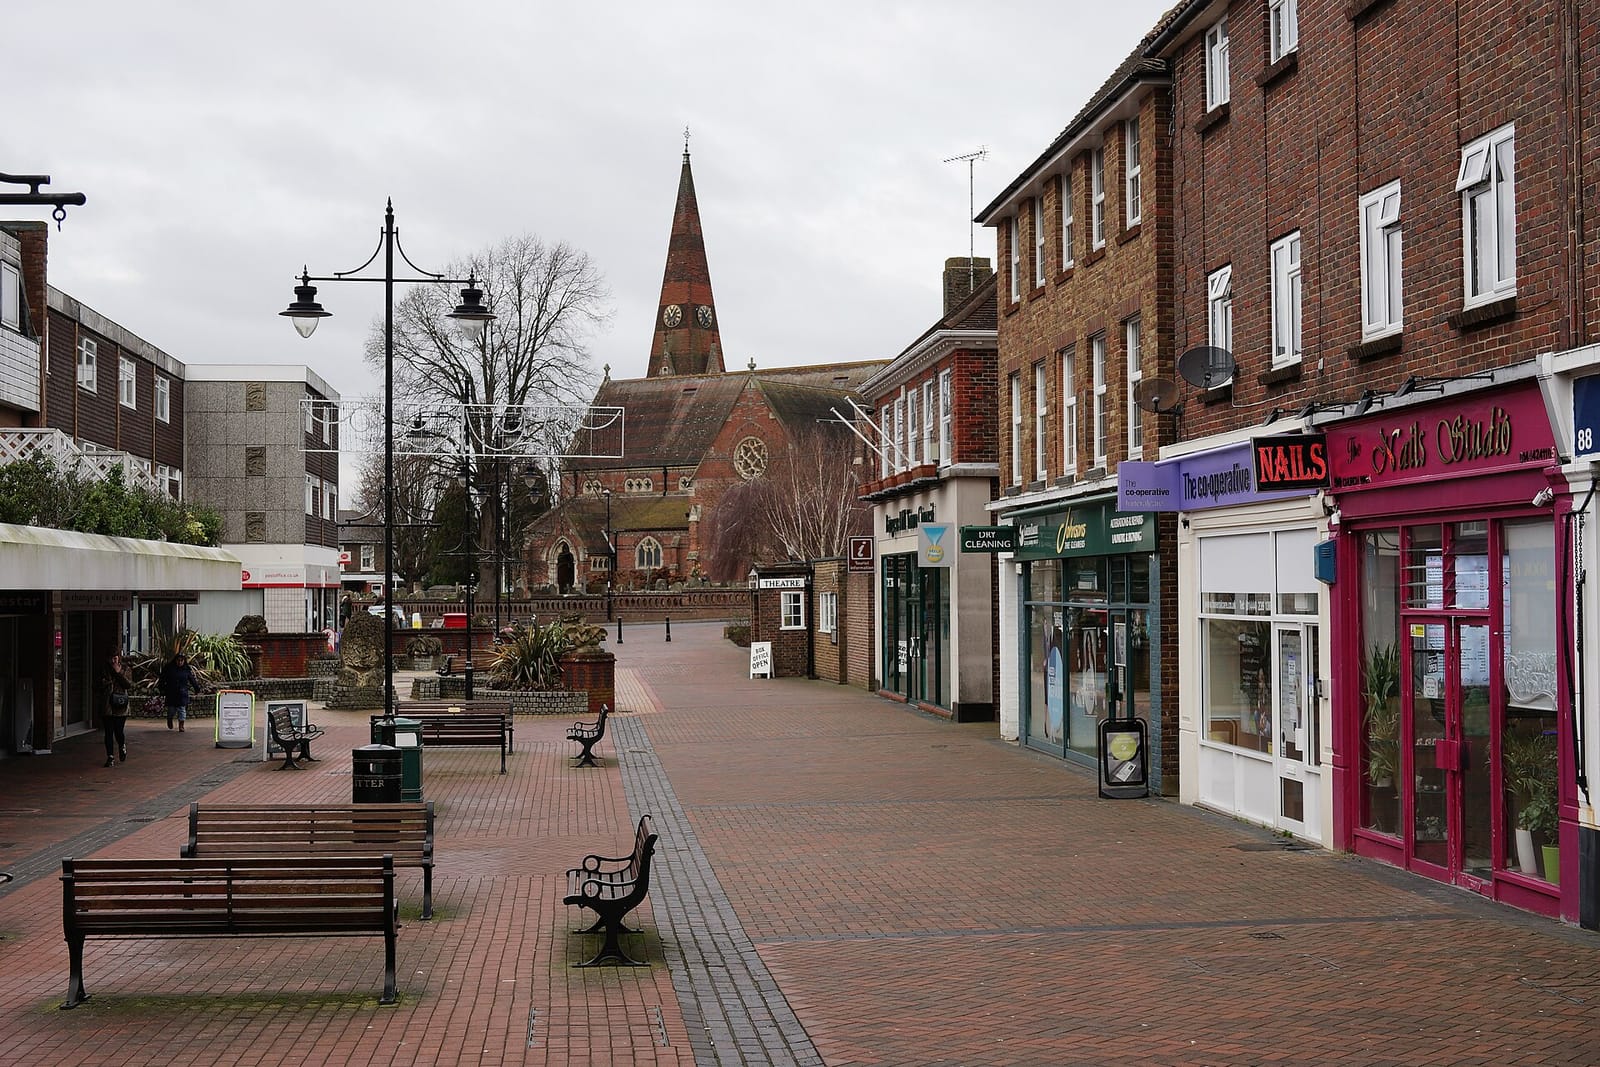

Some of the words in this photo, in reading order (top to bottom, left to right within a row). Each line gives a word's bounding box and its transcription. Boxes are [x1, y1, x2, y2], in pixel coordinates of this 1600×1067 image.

[1372, 421, 1427, 475] Nails
[1436, 407, 1512, 464] Studio
[1577, 428, 1593, 450] 88
[1258, 444, 1327, 483] NAILS
[1125, 479, 1136, 488] The
[1183, 472, 1197, 500] The
[1197, 463, 1250, 503] co-operative
[1125, 488, 1170, 497] co-operative
[1056, 506, 1087, 554] Johnsons
[978, 531, 996, 539] DRY
[965, 539, 1011, 549] CLEANING
[764, 579, 801, 587] THEATRE
[755, 646, 766, 654] BOX
[752, 653, 769, 662] OFFICE
[752, 660, 769, 669] OPEN
